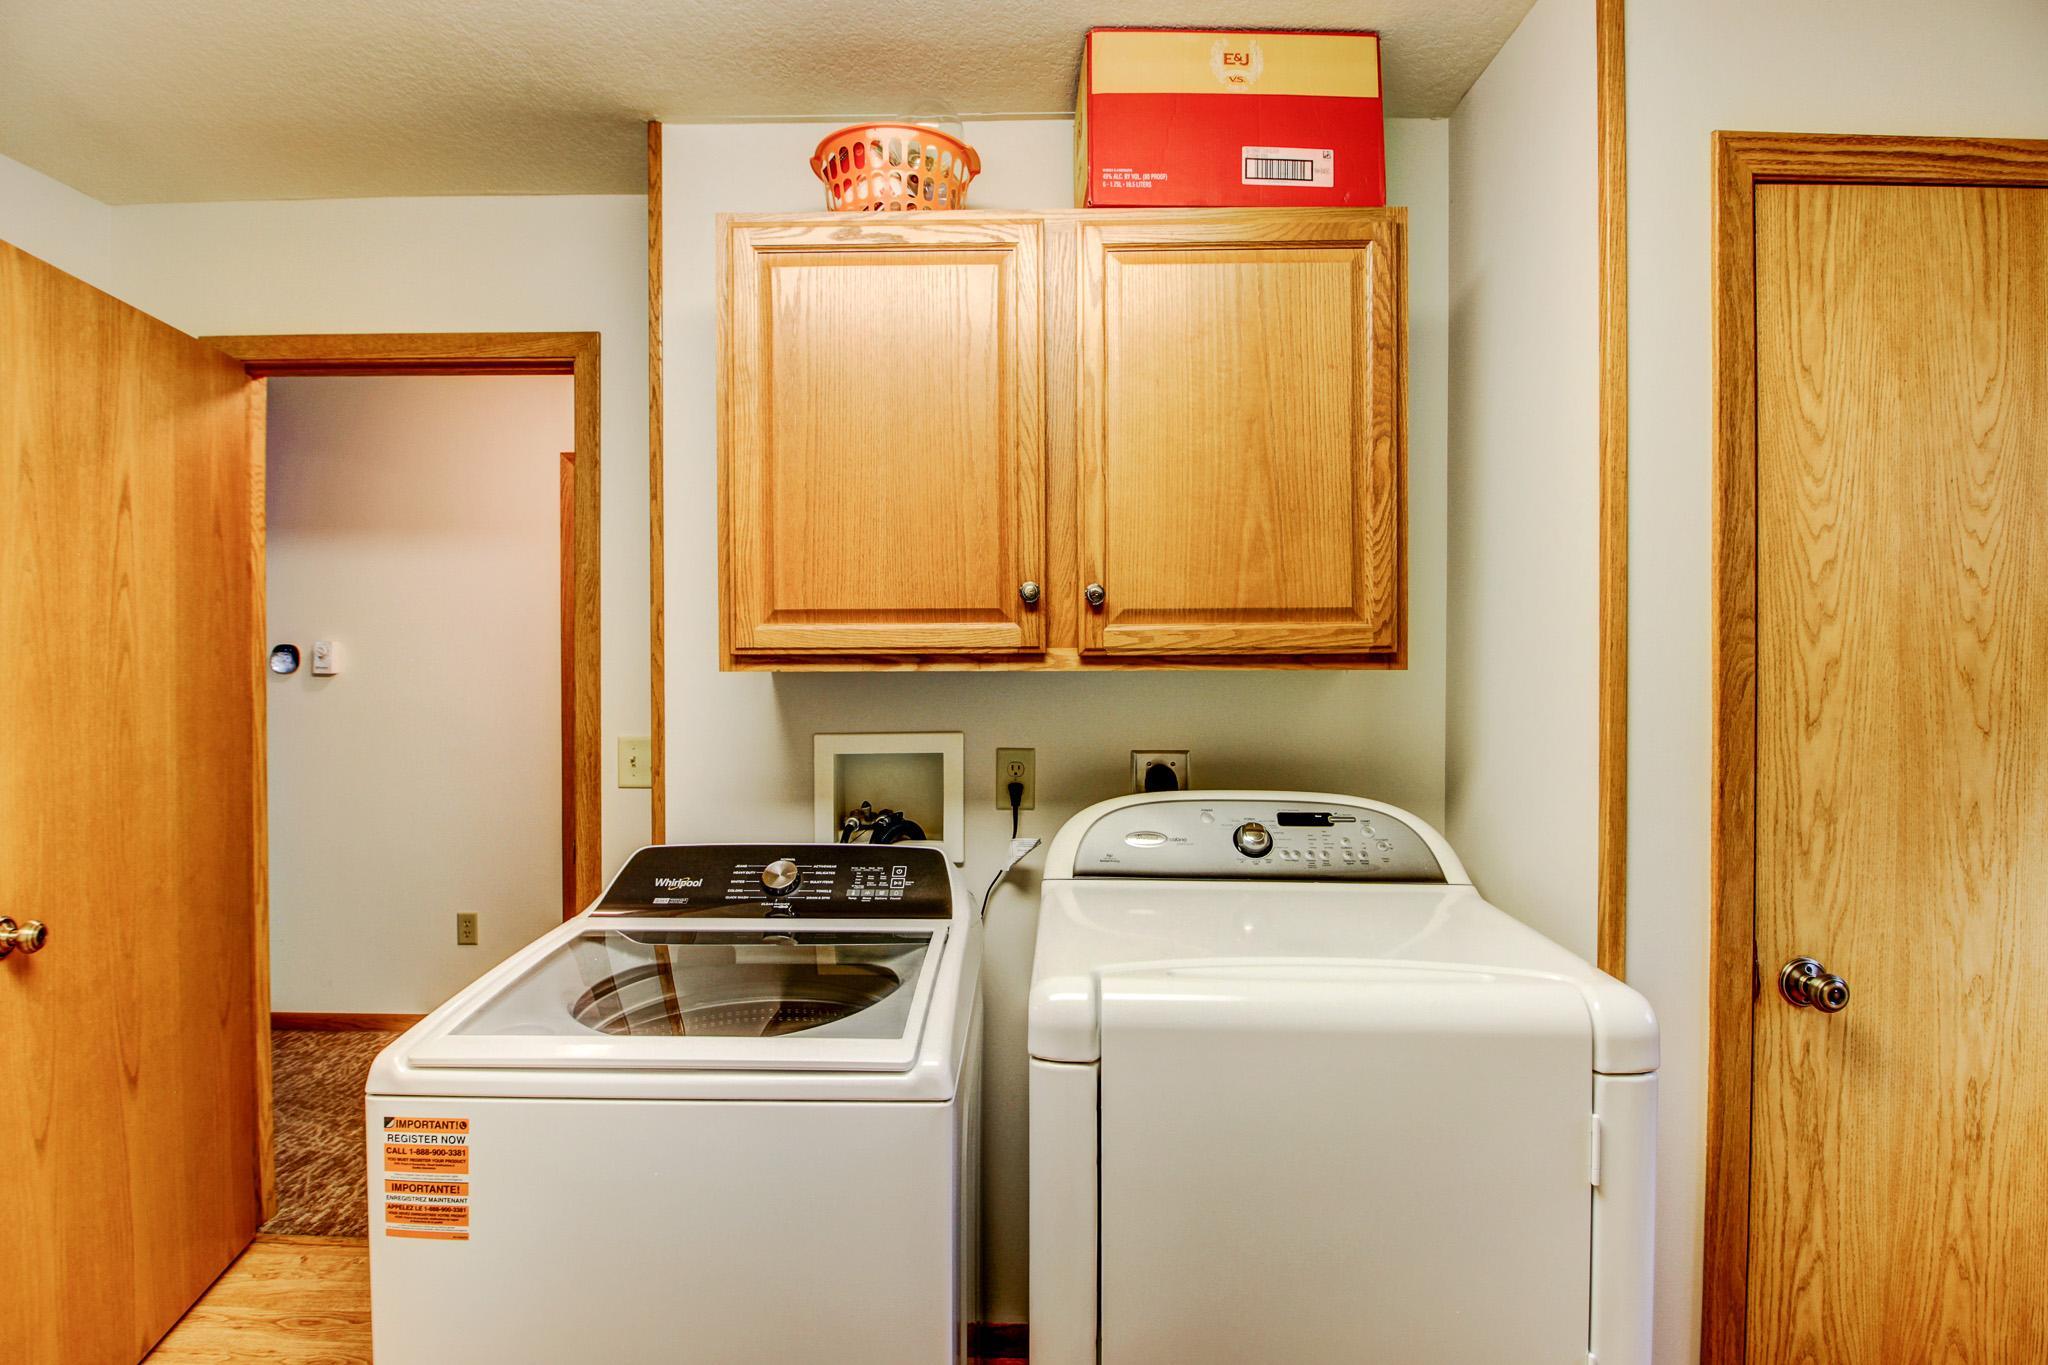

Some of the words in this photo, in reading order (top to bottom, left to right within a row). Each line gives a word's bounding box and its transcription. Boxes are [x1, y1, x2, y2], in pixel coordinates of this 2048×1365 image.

[1223, 53, 1249, 66] E&J
[655, 878, 703, 890] Whirlpool
[396, 1119, 458, 1130] IMPORTANT!
[387, 1133, 438, 1144] REGISTER
[441, 1135, 466, 1145] NOW
[386, 1147, 408, 1155] CALL
[410, 1148, 466, 1157] 1-888-900-3381
[391, 1183, 461, 1194] IMPORTANTE!
